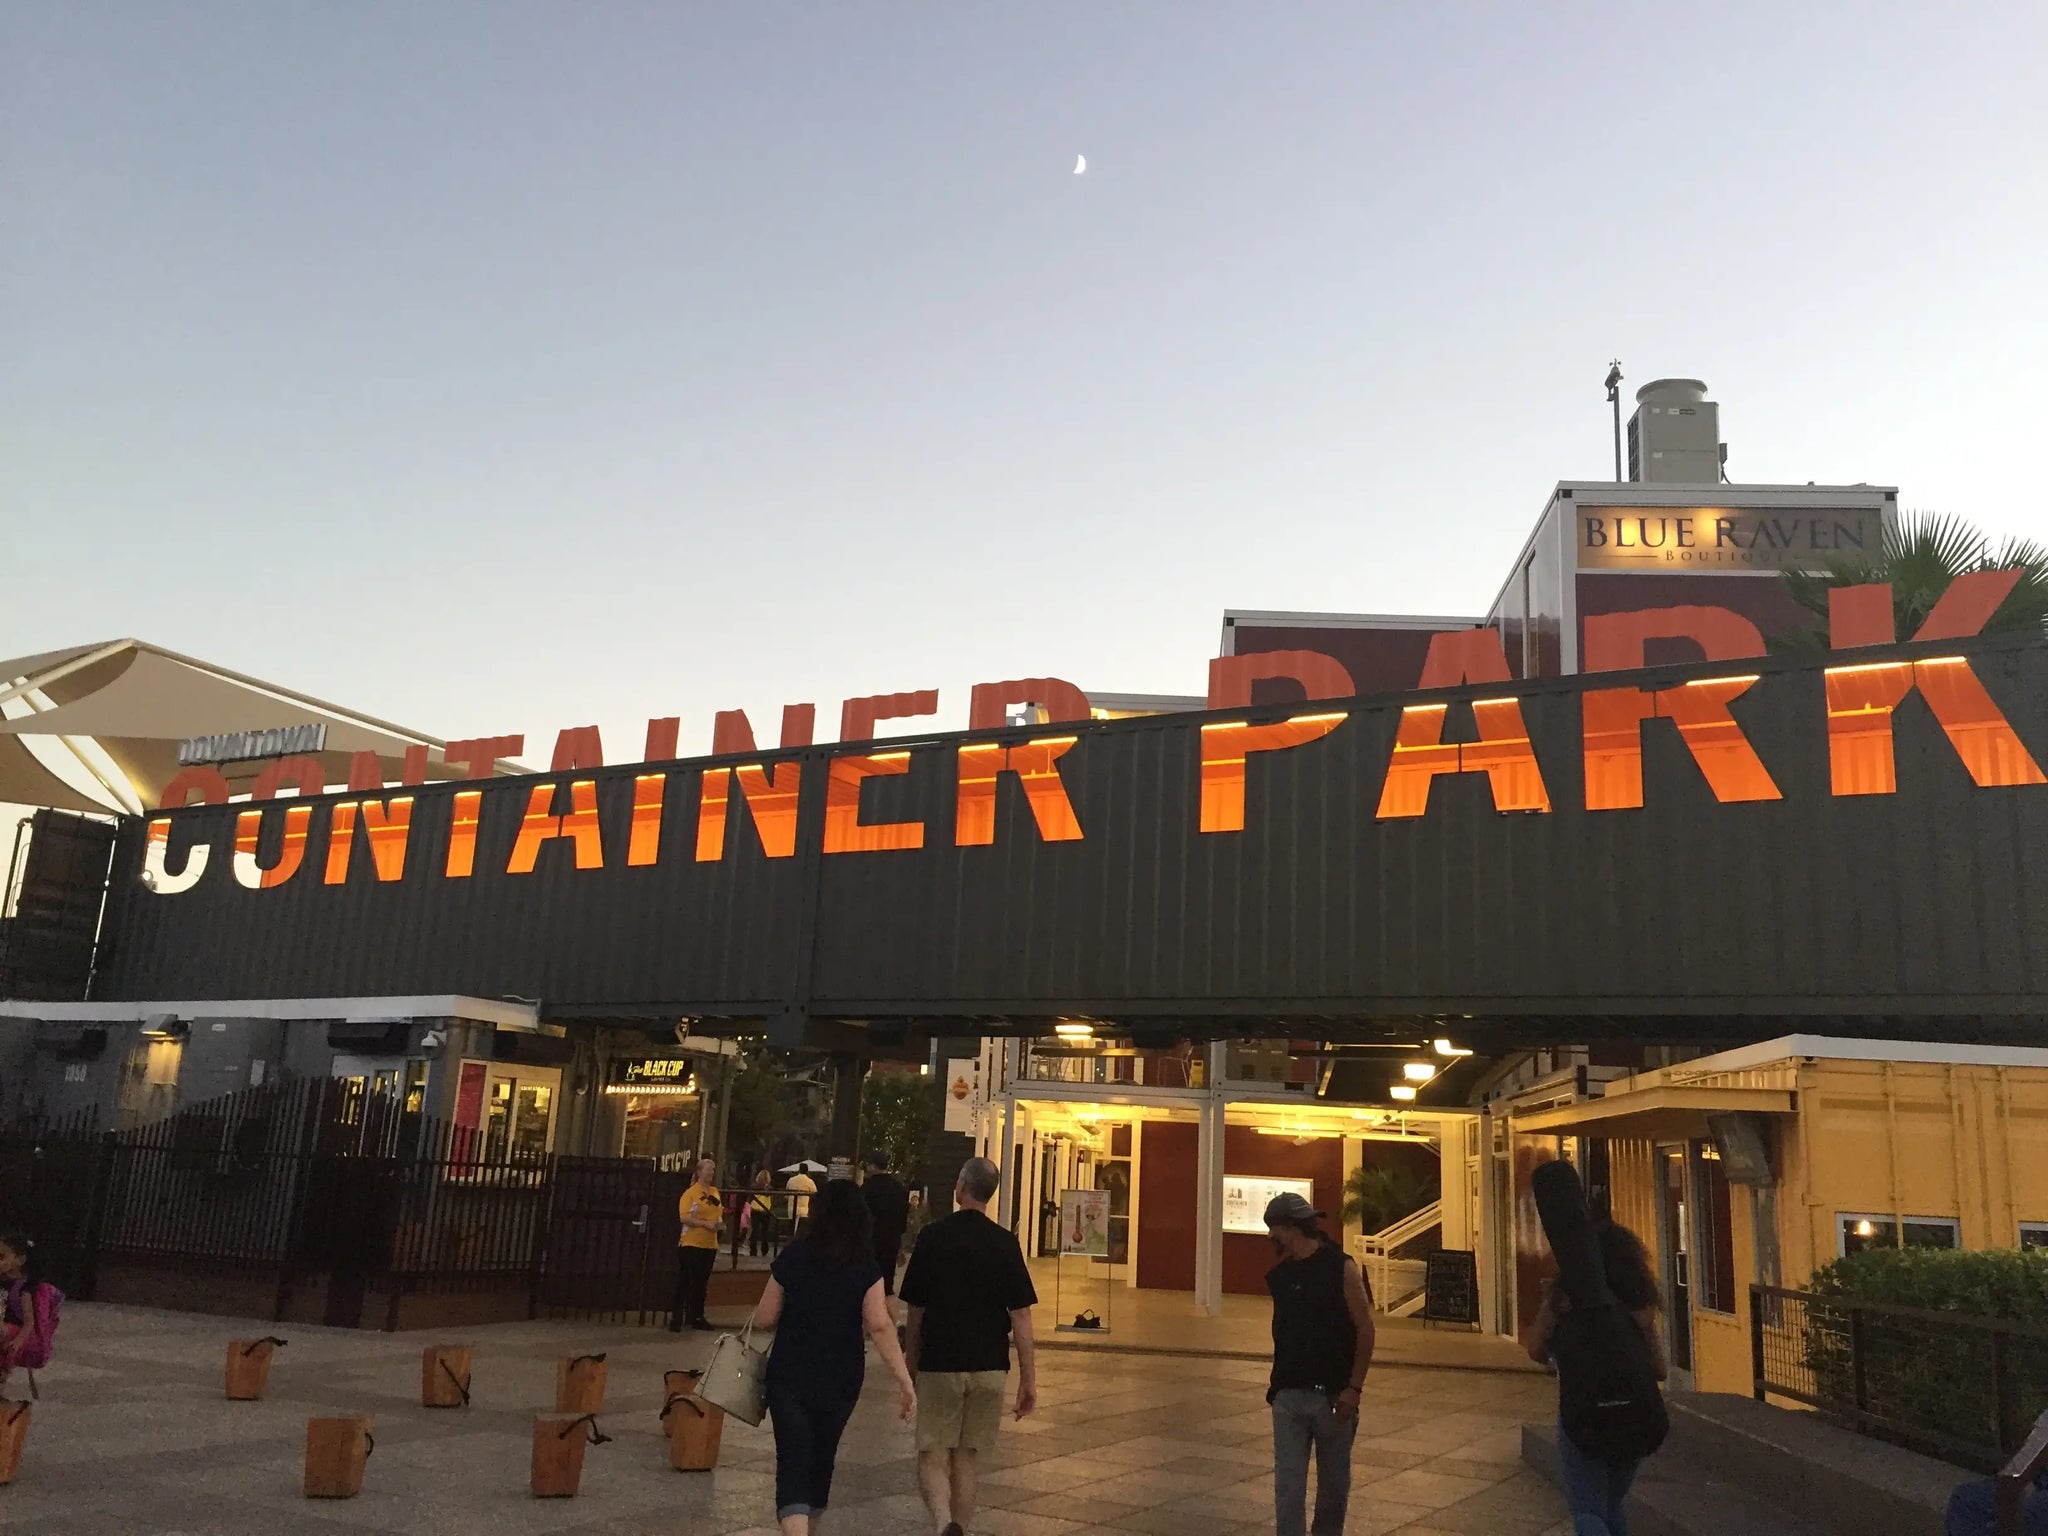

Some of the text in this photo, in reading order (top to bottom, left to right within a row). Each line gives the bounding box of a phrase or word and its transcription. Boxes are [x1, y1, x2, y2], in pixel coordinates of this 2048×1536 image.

[1584, 516, 1864, 550] BLUE RAVEN
[142, 568, 2047, 895] CONTAINER PARK
[177, 724, 328, 767] DOWNTOWN
[642, 1060, 669, 1076] BLACK
[667, 1060, 684, 1076] CUP
